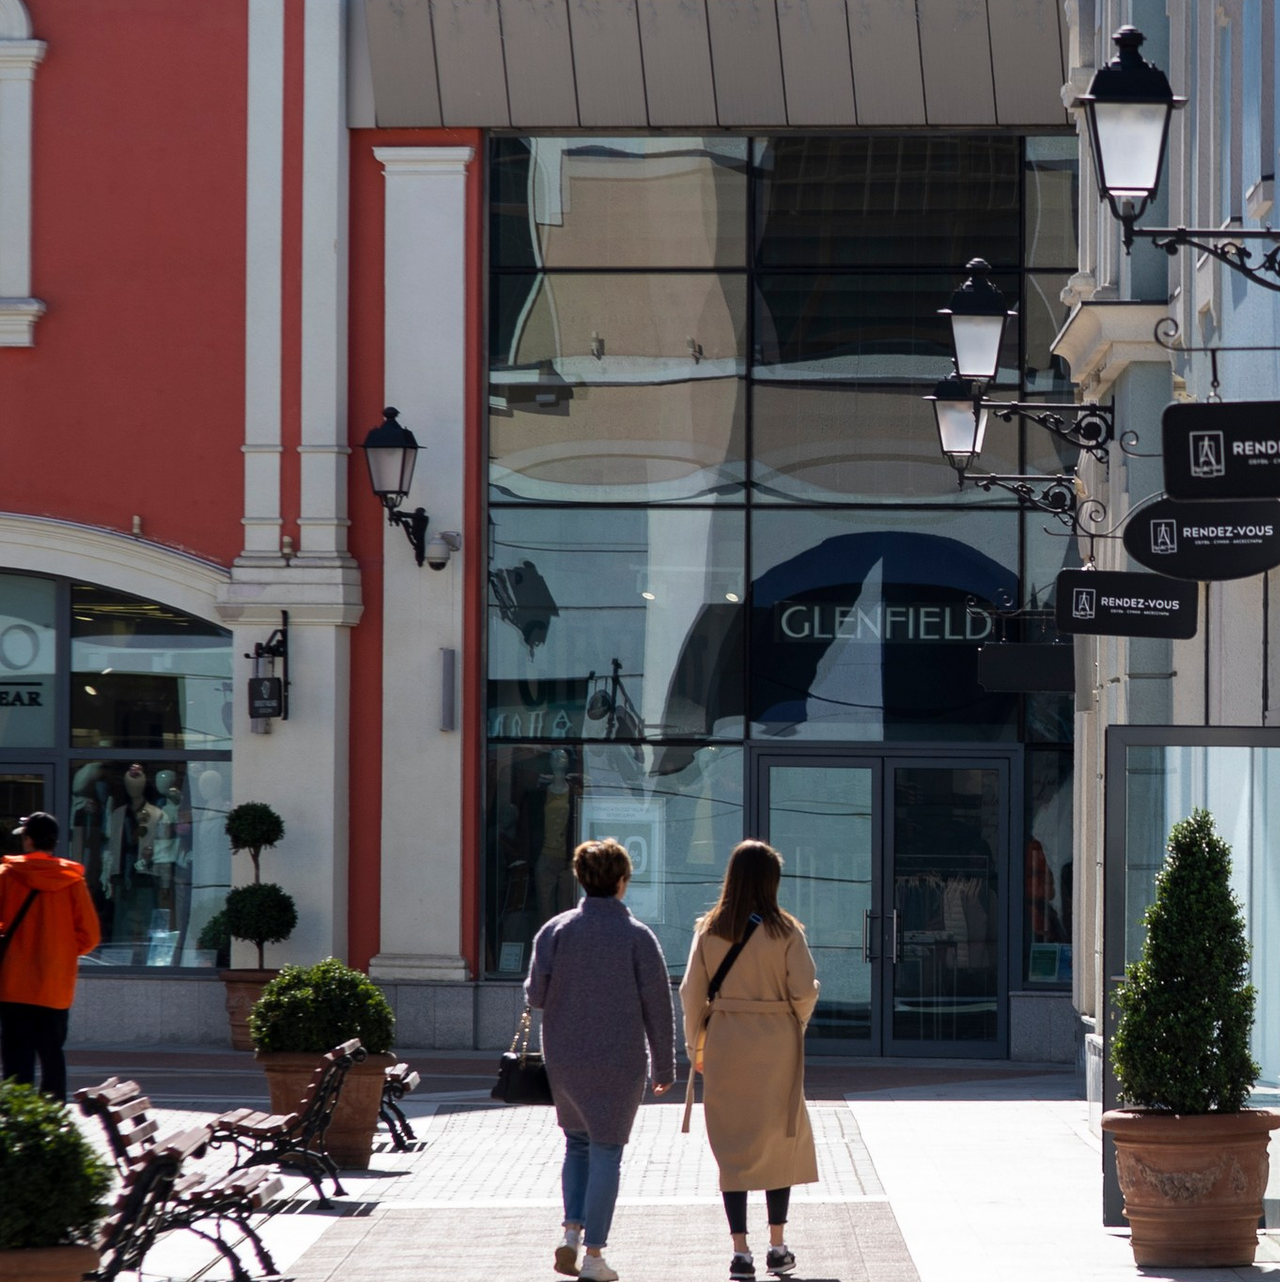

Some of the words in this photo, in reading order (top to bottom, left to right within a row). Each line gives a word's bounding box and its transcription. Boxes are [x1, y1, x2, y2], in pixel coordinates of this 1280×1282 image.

[1183, 525, 1273, 538] RENDEZ-VOUS
[1101, 597, 1179, 610] RENDEZ-VOUS
[781, 606, 992, 640] GLENFIELD
